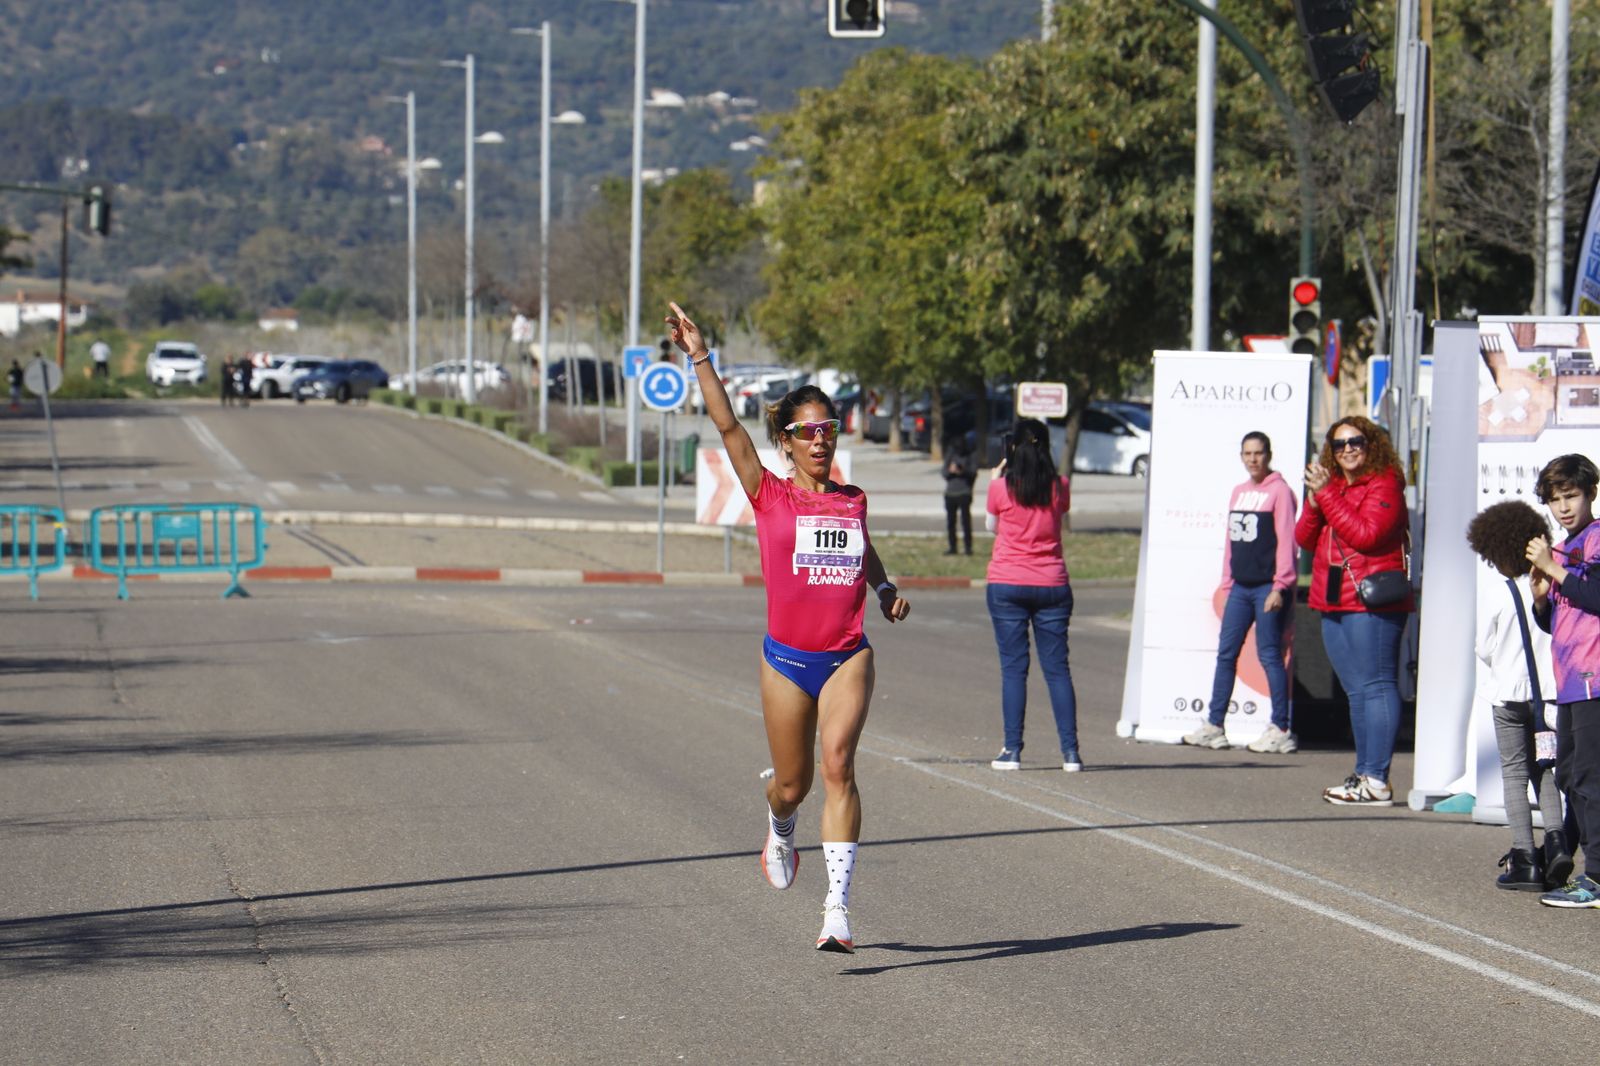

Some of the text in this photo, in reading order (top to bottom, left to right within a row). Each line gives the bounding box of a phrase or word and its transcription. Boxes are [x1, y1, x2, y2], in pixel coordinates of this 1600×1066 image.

[1234, 490, 1270, 511] LADY
[1229, 512, 1259, 543] 53
[814, 529, 848, 549] 1119
[807, 576, 854, 586] RUNNING
